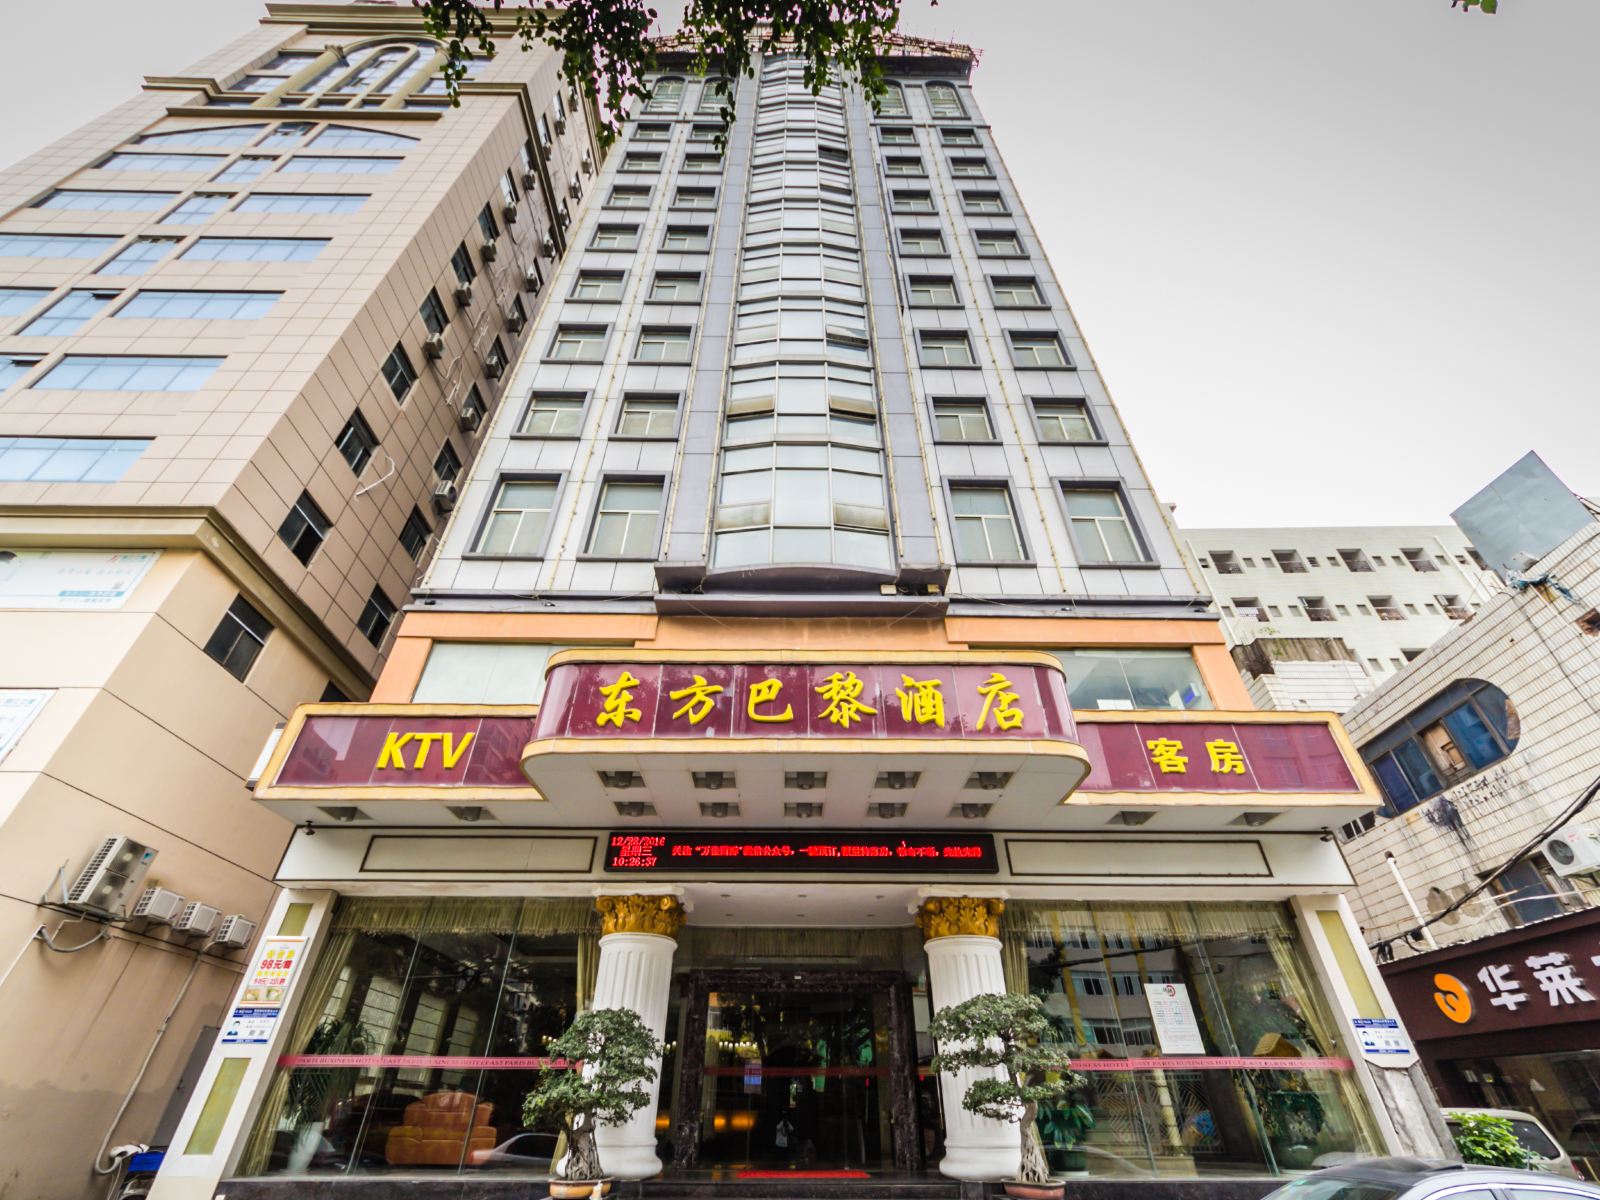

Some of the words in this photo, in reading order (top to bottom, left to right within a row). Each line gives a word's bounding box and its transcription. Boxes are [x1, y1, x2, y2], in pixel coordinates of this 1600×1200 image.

[595, 670, 1024, 732] 东方巴黎酒店
[376, 731, 476, 771] KTV
[1146, 737, 1247, 775] 客房
[1477, 950, 1600, 1011] 华莱
